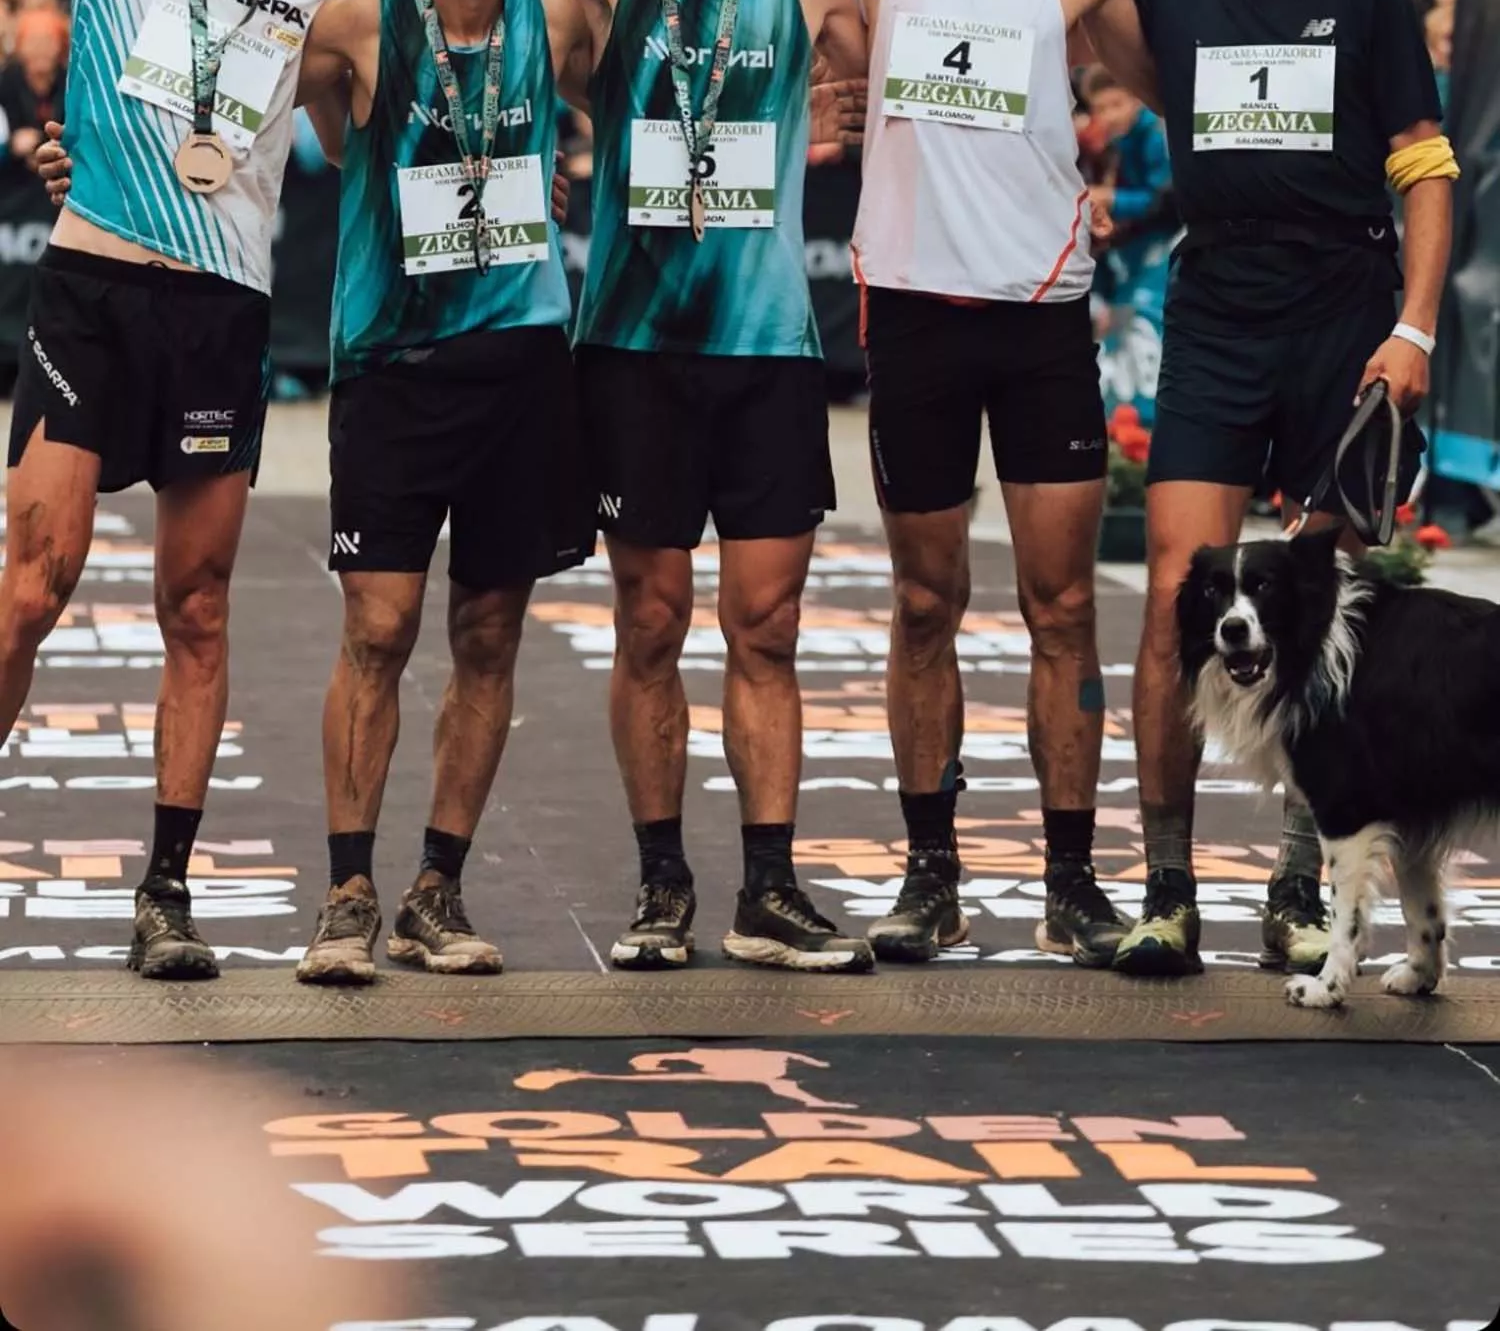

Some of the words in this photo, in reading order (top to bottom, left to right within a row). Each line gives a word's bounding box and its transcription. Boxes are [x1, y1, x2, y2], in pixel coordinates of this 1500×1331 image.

[942, 40, 973, 76] 4
[139, 63, 245, 126] ZEGMA
[899, 81, 1010, 112] ZEGAMA
[1249, 66, 1269, 101] 1
[926, 108, 976, 122] SALOMON
[1207, 112, 1317, 133] ZEGAMA
[1240, 102, 1280, 110] MANUEL
[1234, 137, 1284, 146] SALOMON
[456, 183, 486, 221] 2
[418, 225, 532, 256] ZEGMA
[33, 340, 77, 407] SCARPA
[262, 1109, 1247, 1142] GOLDEN
[268, 1136, 1318, 1183] TRAIL
[288, 1179, 1342, 1223] WORLD
[313, 1220, 1387, 1265] SERIES
